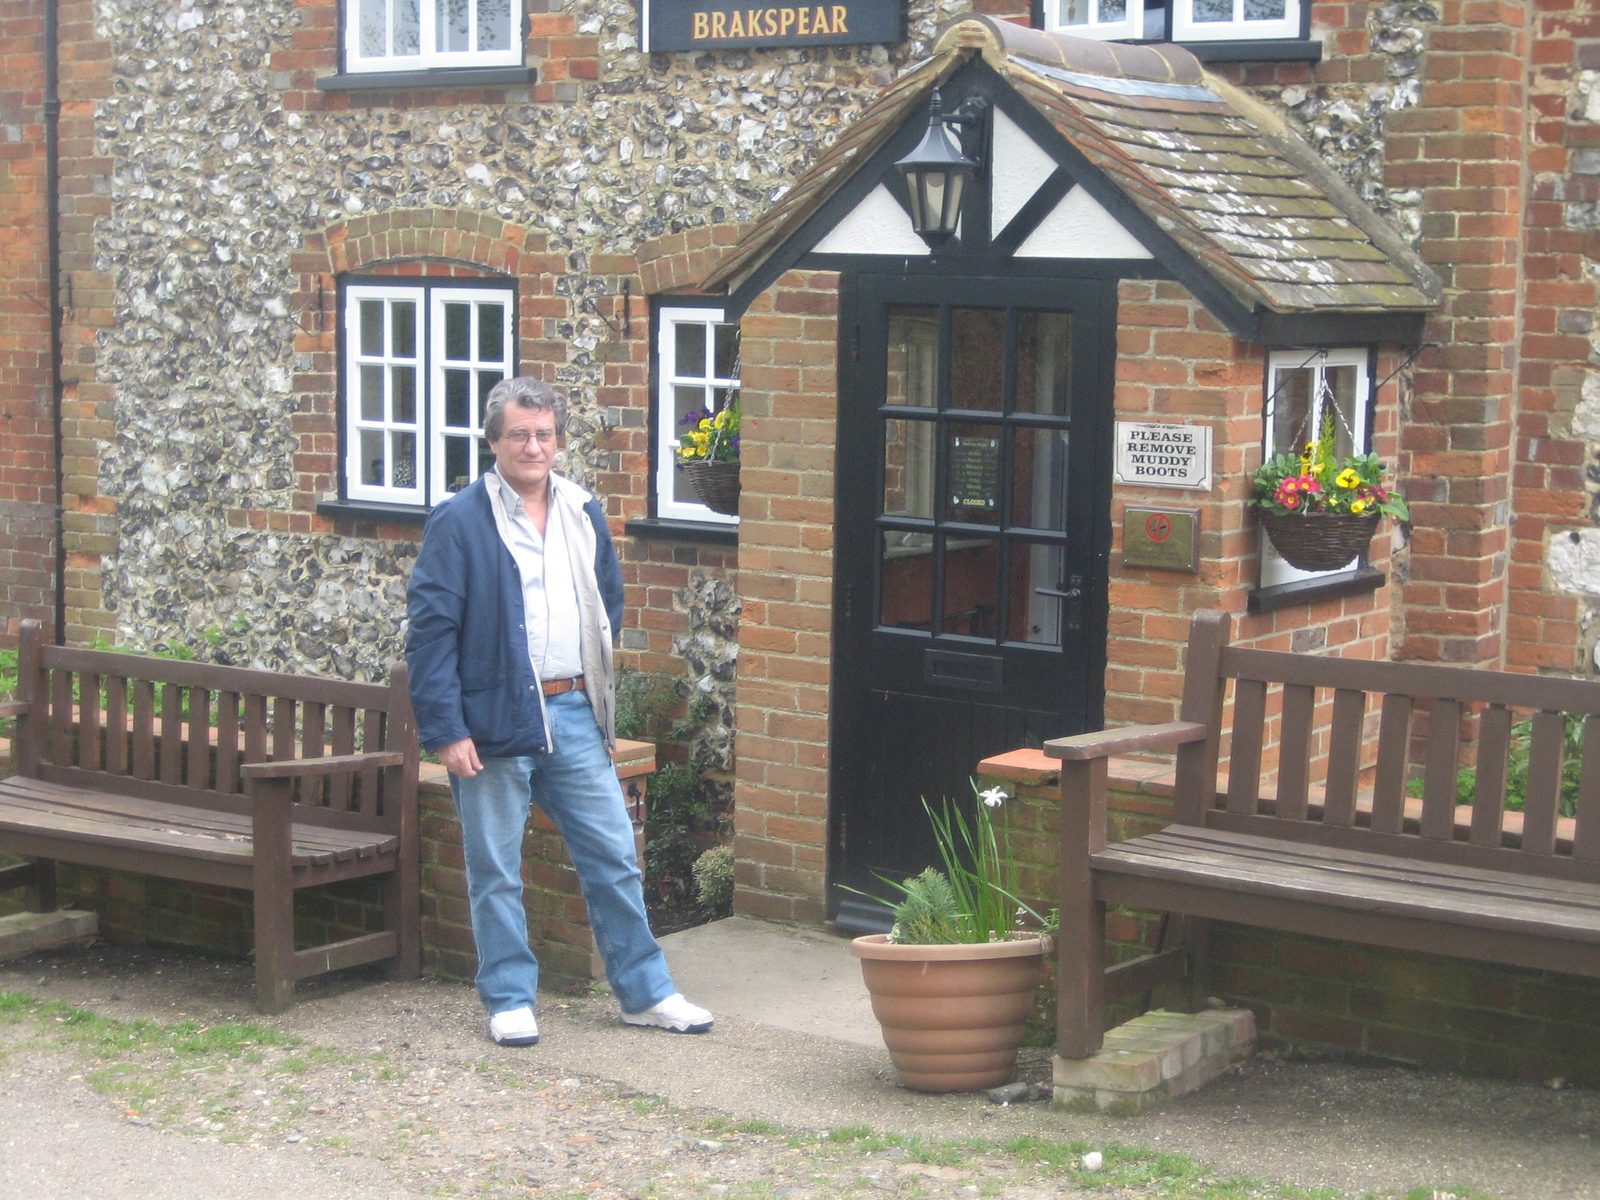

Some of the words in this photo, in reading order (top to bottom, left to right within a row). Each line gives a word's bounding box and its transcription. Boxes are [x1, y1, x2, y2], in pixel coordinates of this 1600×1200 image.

[692, 5, 849, 40] BRAKSPEAR
[1130, 431, 1193, 443] PLEASE
[1127, 443, 1196, 455] REMOVE
[1131, 454, 1191, 466] MUDDY
[1135, 466, 1188, 478] BOOTS
